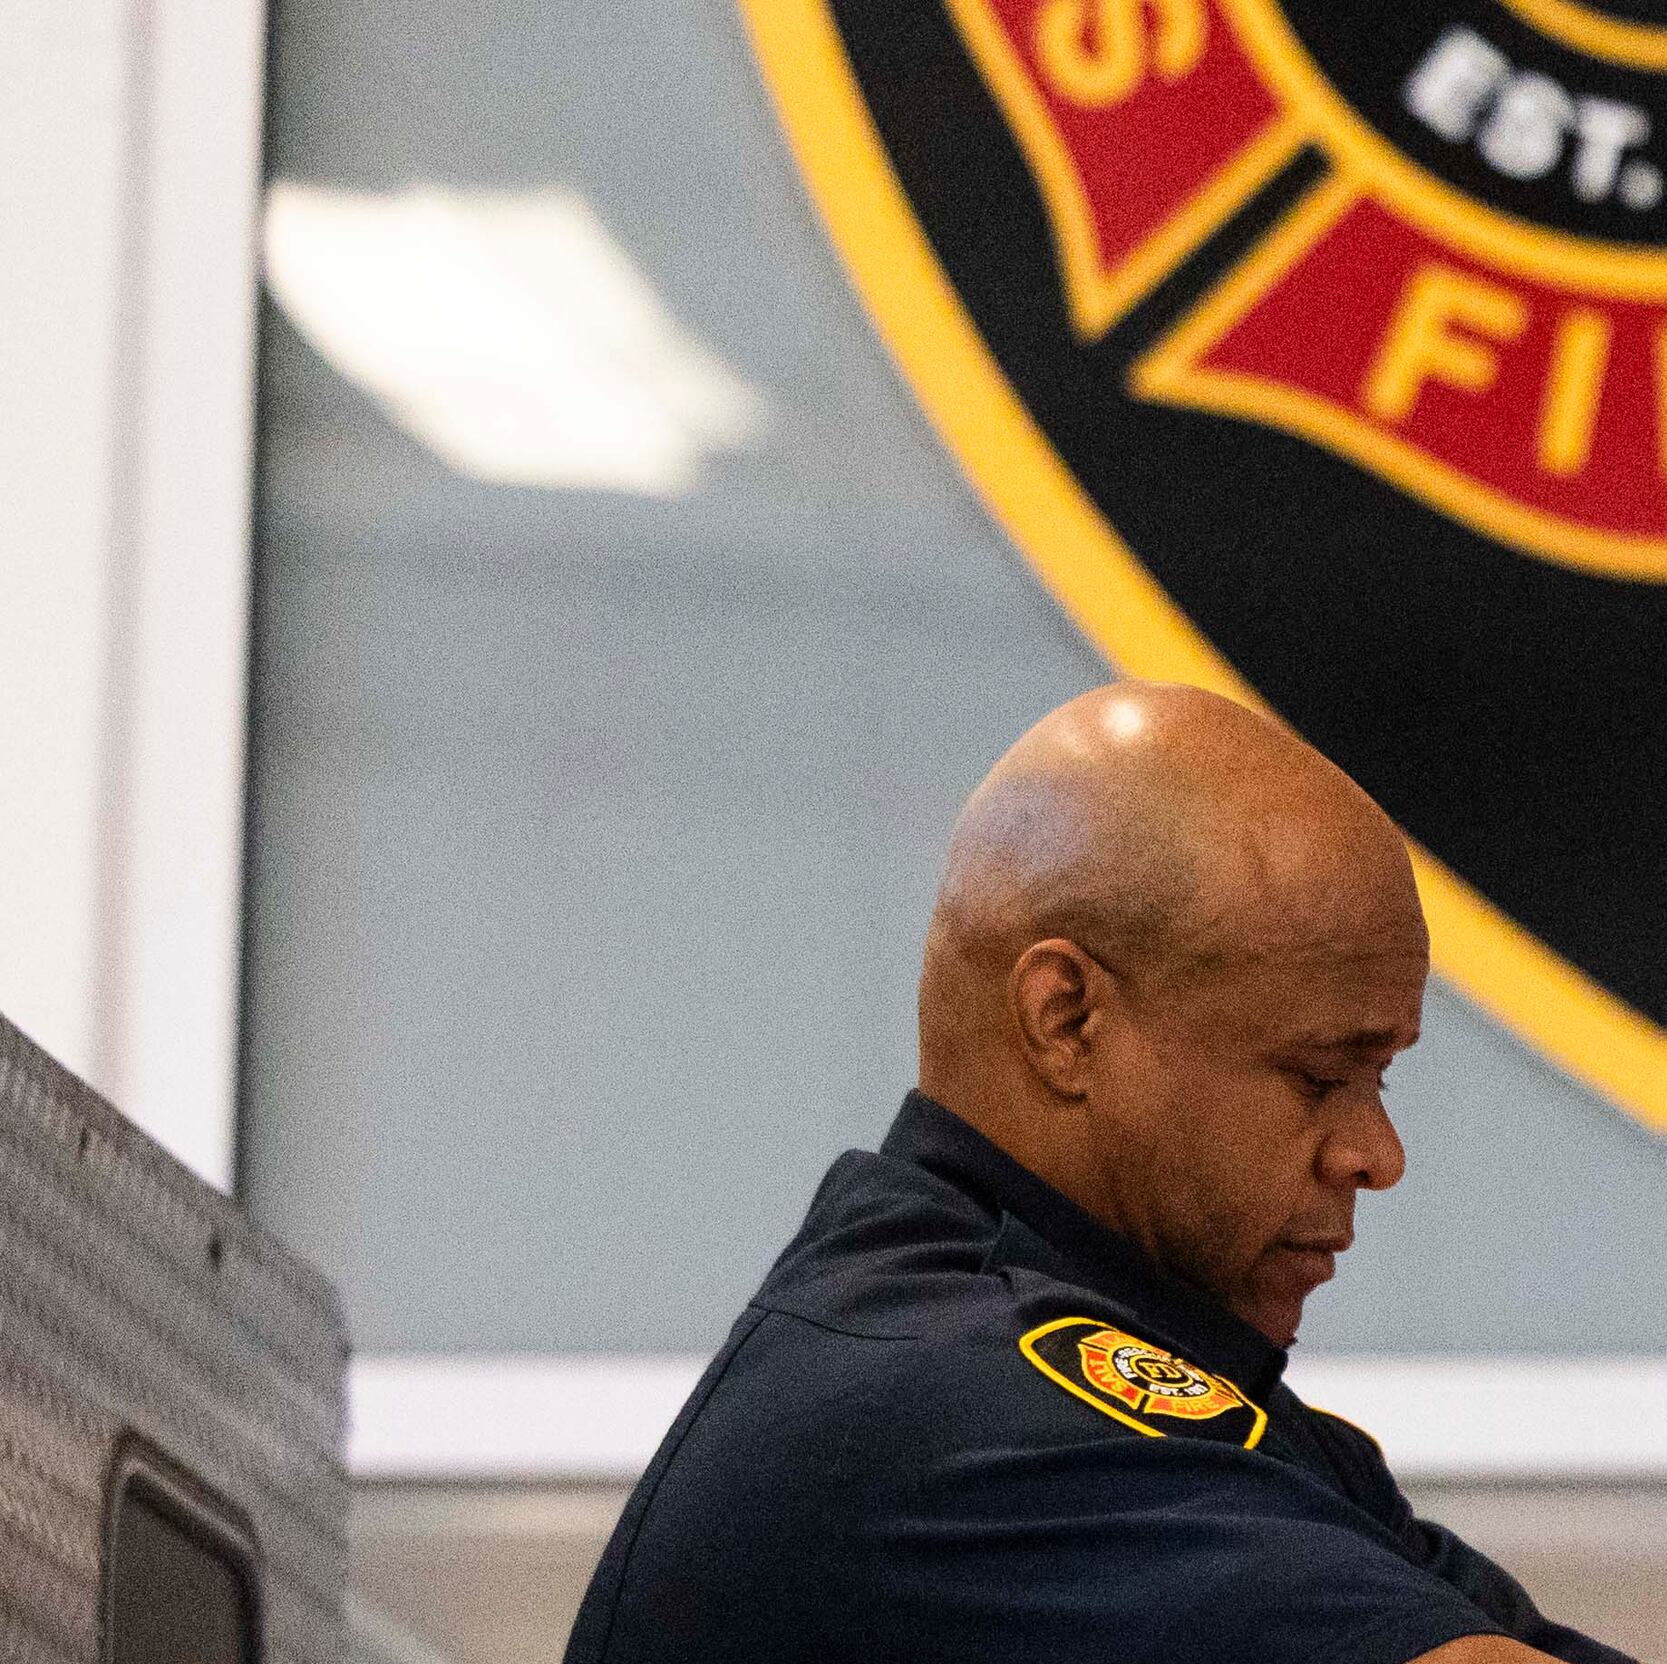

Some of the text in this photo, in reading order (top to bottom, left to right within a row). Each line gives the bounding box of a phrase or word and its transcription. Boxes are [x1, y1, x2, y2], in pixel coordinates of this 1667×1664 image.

[1404, 26, 1664, 211] EST.
[1088, 1357, 1126, 1393] SALT
[1172, 1399, 1220, 1412] FIRE
